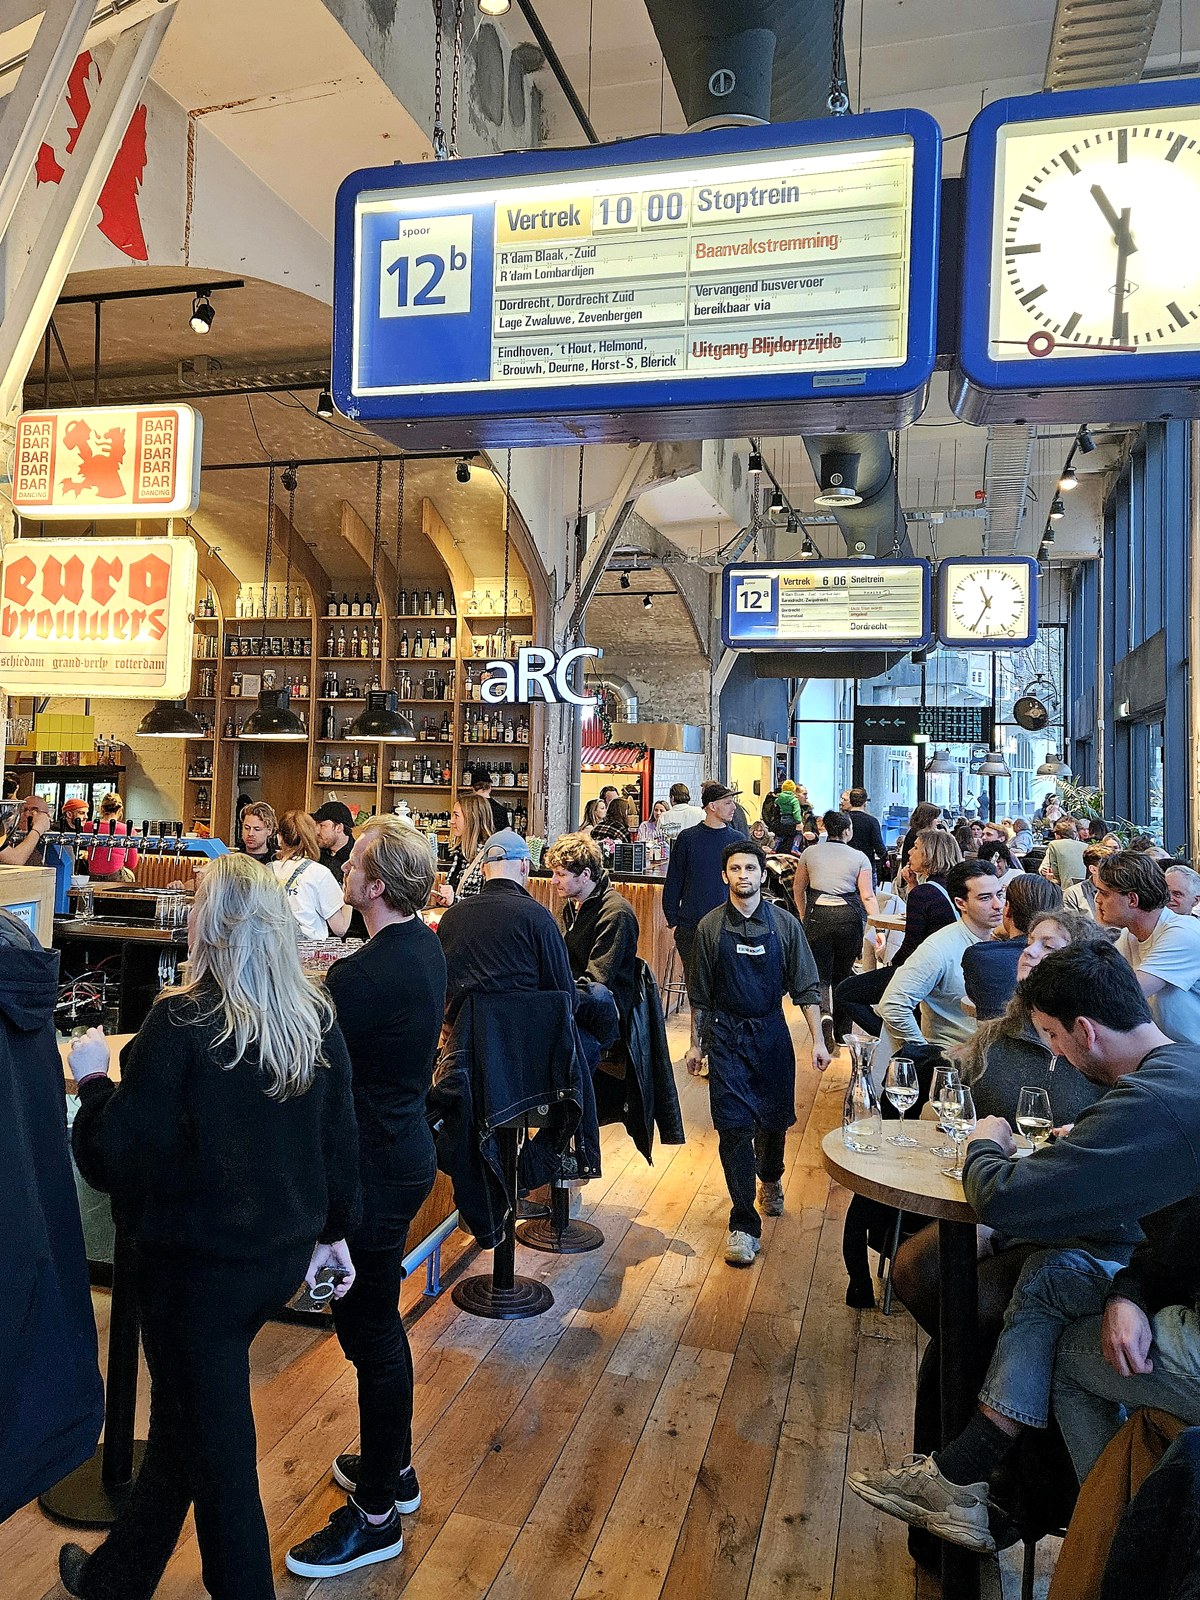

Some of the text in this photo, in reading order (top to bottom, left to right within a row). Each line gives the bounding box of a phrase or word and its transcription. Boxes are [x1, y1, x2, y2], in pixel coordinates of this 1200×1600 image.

[507, 180, 800, 232] Vertrek 10 00 Stoptrein
[402, 225, 431, 239] spoor
[695, 232, 839, 259] Baanvakstremming
[386, 245, 467, 307] 12b
[535, 266, 594, 280] Lombardijen
[696, 277, 824, 297] Vervangend busvervoer
[499, 290, 635, 311] Dordrecht, Dordrecht Zuid
[694, 299, 771, 316] bereikbaar via
[499, 310, 643, 330] Lage Zwaluwe, Zevenbergen
[498, 344, 553, 359] Eindhoven,
[568, 342, 596, 355] Hout,
[599, 338, 647, 353] Helmond,
[692, 332, 842, 361] Uitgang Blijdorpzijde
[498, 355, 677, 376] -Brouwh, Deurne, Horst-S, Blerick
[24, 424, 50, 436] BAR
[145, 419, 173, 432] BAR
[22, 438, 49, 448] BAR
[144, 433, 172, 445] BAR
[22, 451, 48, 462] BAR
[144, 448, 171, 460] BAR
[21, 464, 47, 476] BAR
[143, 461, 170, 473] BAR
[20, 478, 46, 490] BAR
[142, 476, 170, 488] BAR
[4, 553, 171, 606] euro
[783, 575, 885, 586] Vertrek 6 06 Sneltrein
[740, 591, 769, 608] 12a
[2, 604, 168, 641] brouwers
[0, 654, 45, 669] schiedam
[115, 658, 165, 670] rotterdam
[918, 712, 982, 723] TOILETTEN
[918, 723, 982, 736] TOILETTEN
